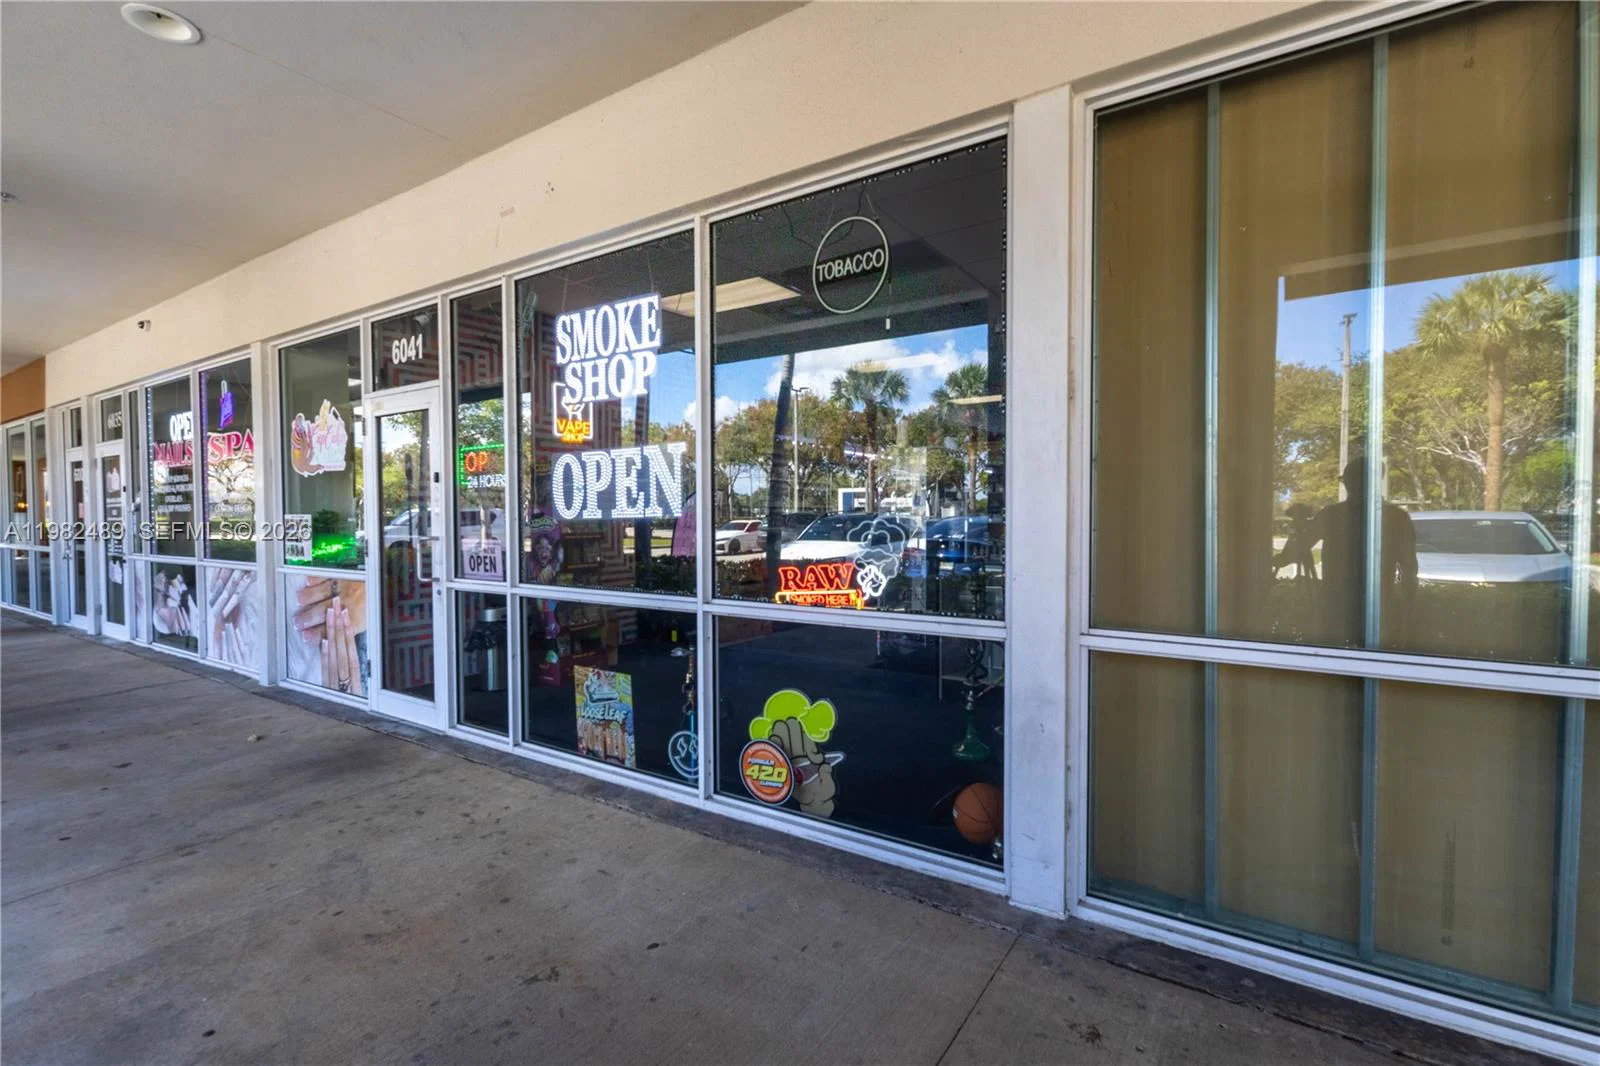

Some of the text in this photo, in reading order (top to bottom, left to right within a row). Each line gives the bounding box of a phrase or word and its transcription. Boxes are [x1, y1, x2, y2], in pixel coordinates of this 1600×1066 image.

[816, 248, 885, 282] TOBACCO
[556, 294, 662, 366] SMOKE
[392, 333, 423, 365] 6041
[564, 350, 658, 405] SHOP
[169, 411, 193, 441] OPE
[556, 419, 591, 436] VAPE
[152, 438, 193, 467] NAILS
[207, 427, 255, 464] SPA
[464, 451, 490, 472] OP
[552, 443, 687, 520] OPEN
[469, 555, 497, 573] OPEN
[778, 563, 855, 591] RAW
[746, 764, 788, 783] 420
